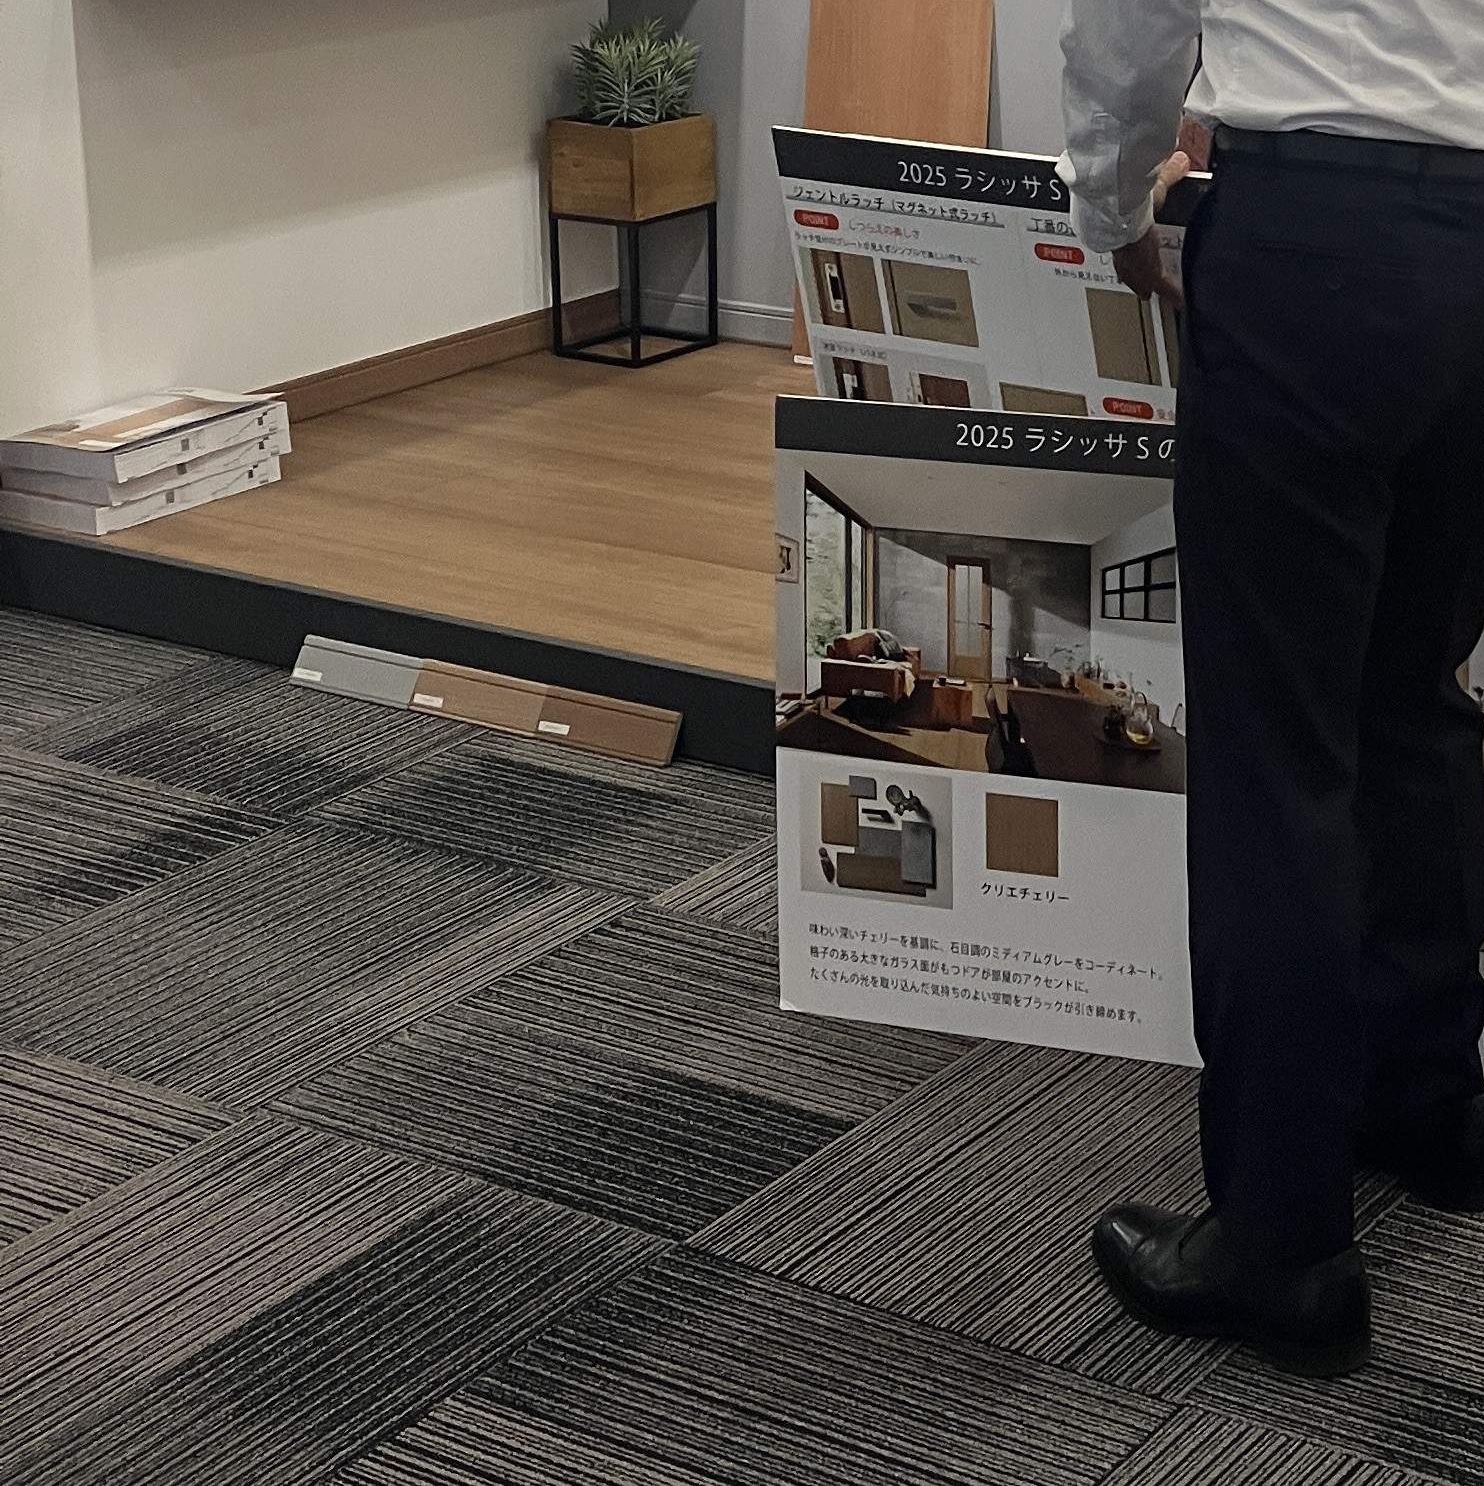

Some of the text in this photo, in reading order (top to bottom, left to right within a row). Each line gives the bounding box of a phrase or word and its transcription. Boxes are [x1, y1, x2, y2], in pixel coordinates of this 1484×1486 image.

[897, 161, 947, 187] 2025
[955, 423, 1014, 450] 2025
[980, 882, 1070, 903] クリエチェリー
